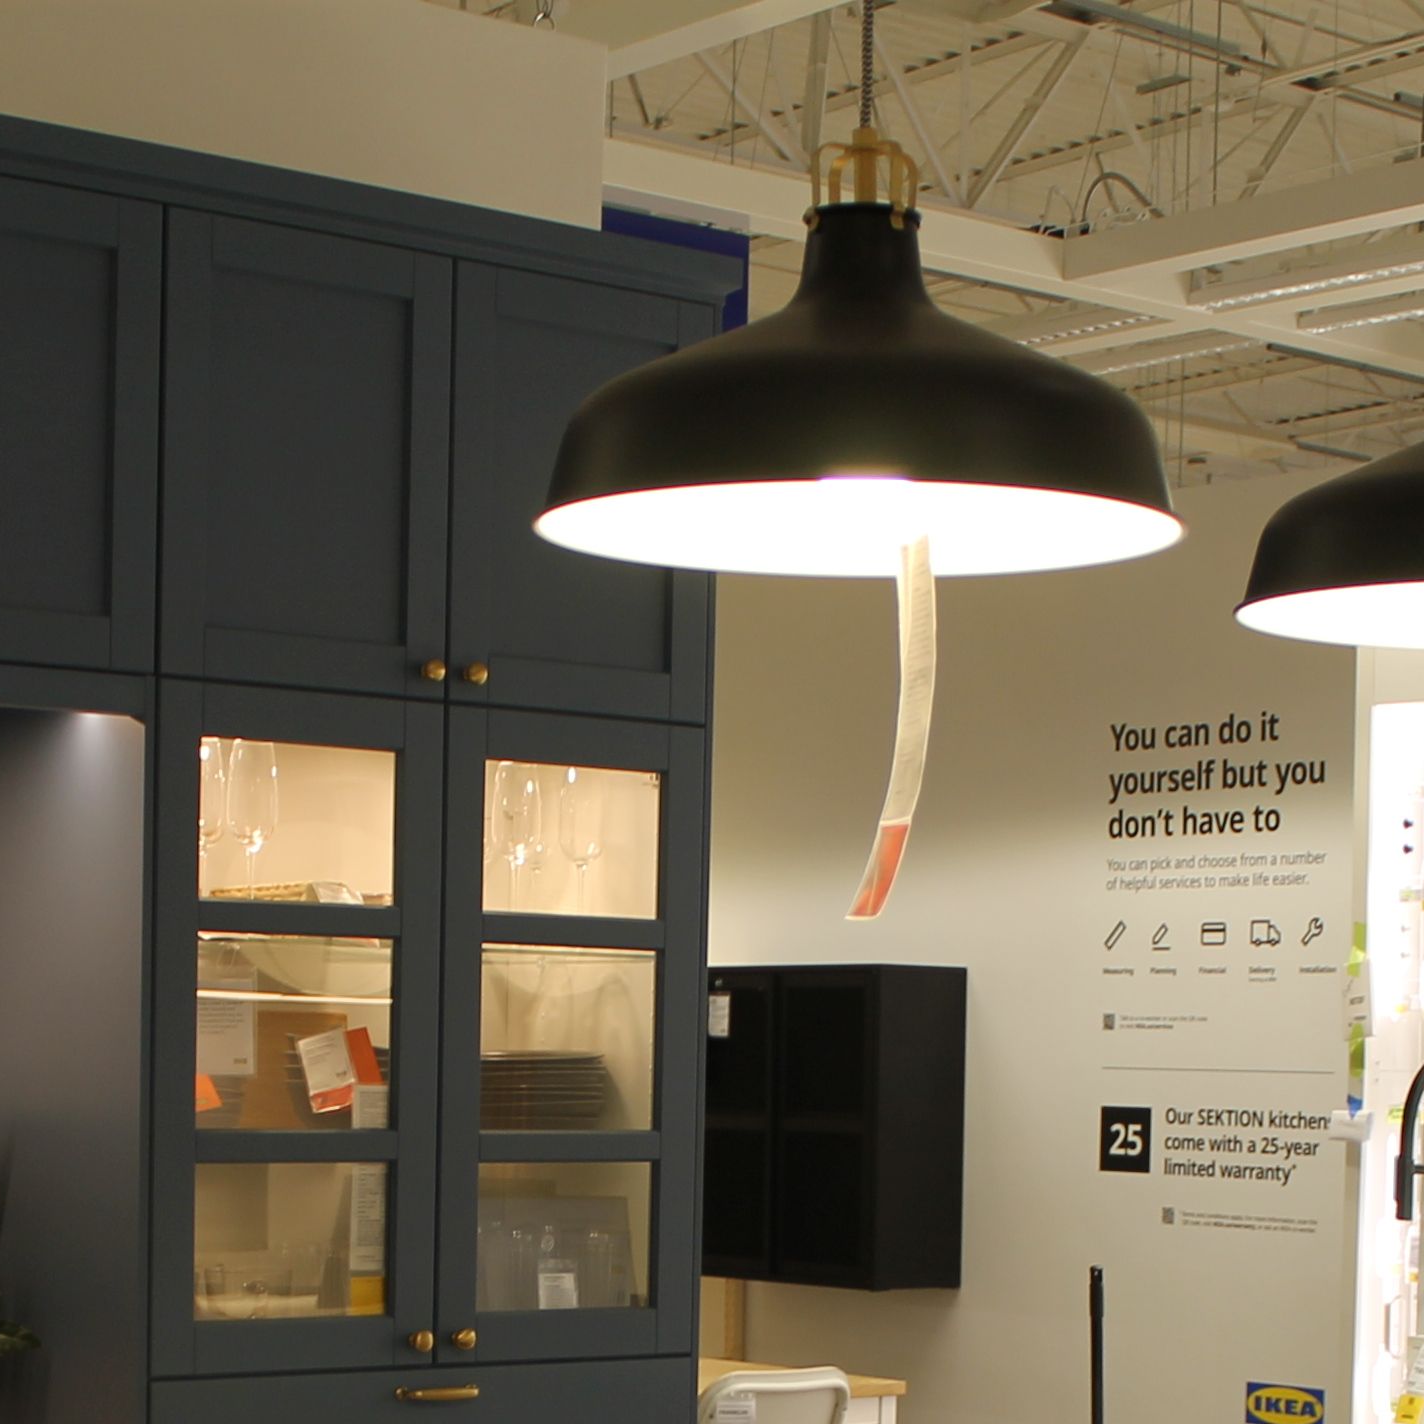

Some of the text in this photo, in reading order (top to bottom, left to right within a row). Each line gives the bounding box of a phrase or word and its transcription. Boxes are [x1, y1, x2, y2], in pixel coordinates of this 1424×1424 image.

[1110, 711, 1280, 752] You can do it
[1109, 758, 1326, 804] yourself but you
[1109, 805, 1282, 838] don’t have to
[1107, 857, 1127, 872] You
[1128, 860, 1149, 871] can
[1150, 856, 1172, 874] pick
[1175, 855, 1196, 869] and
[1197, 854, 1238, 869] choose
[1240, 853, 1268, 867] from
[1280, 852, 1327, 866] number
[1106, 876, 1118, 890] of
[1119, 875, 1156, 893] helpful
[1159, 875, 1202, 889] services
[1204, 876, 1216, 888] to
[1218, 874, 1250, 888] make
[1252, 872, 1270, 886] life
[1165, 1107, 1330, 1130] Our SEKTION kitchen
[1109, 1123, 1143, 1156] 25
[1164, 1135, 1320, 1160] come with a 25-year
[1164, 1158, 1215, 1177] limited
[1254, 1395, 1318, 1418] IKEA
